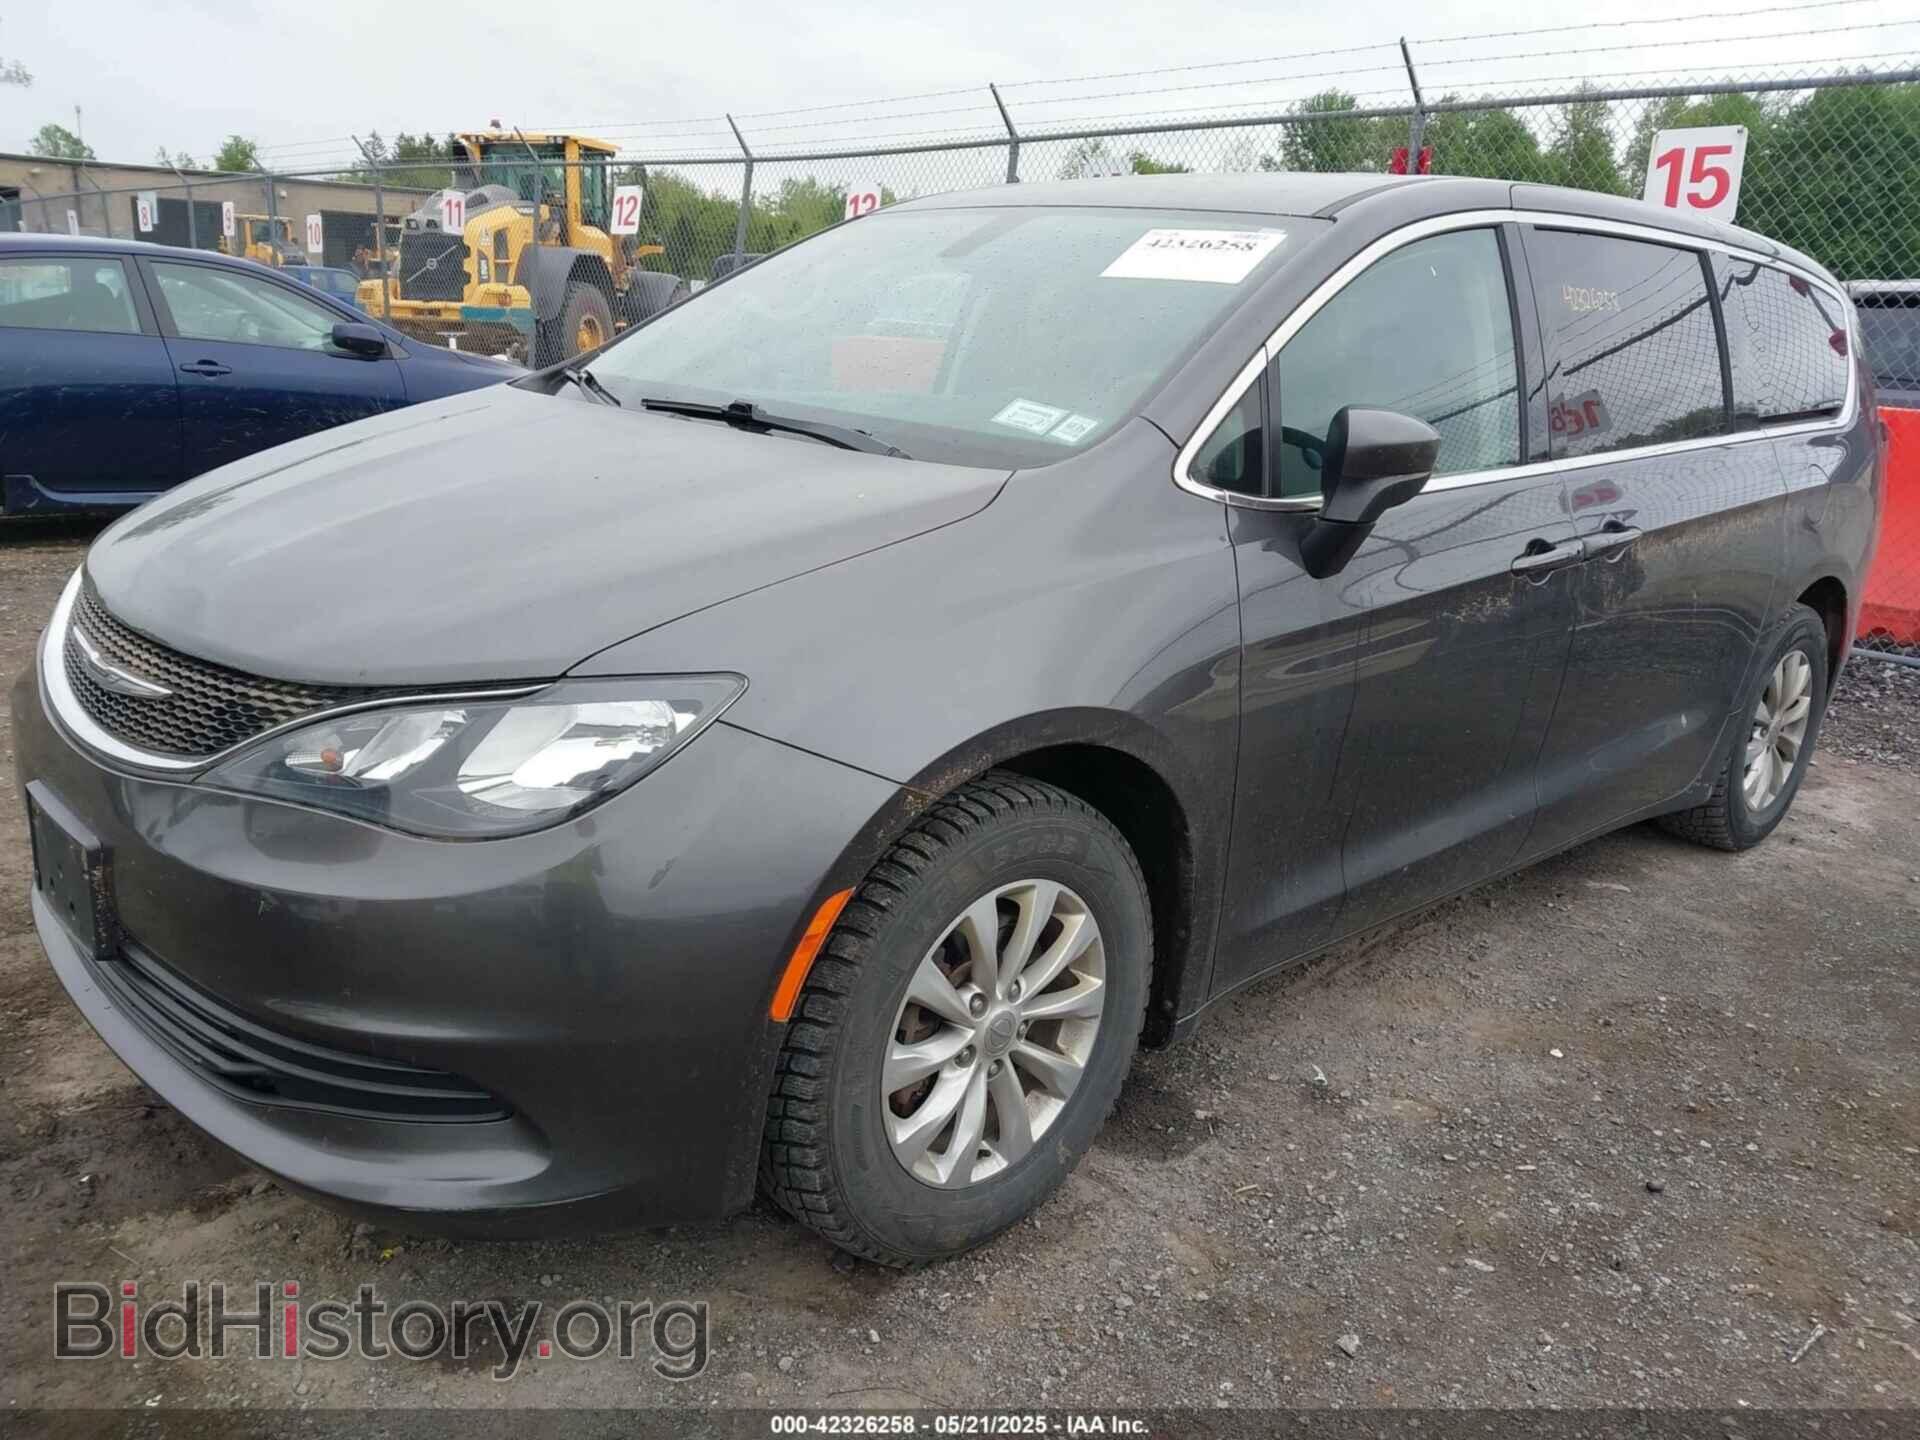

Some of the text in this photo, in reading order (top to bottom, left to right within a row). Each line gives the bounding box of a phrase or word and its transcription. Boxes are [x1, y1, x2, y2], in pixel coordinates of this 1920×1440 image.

[1655, 144, 1733, 209] 15
[141, 206, 149, 226] 8
[224, 207, 233, 230] 9
[443, 198, 463, 228] 11
[614, 194, 639, 227] 12
[307, 222, 321, 246] 10
